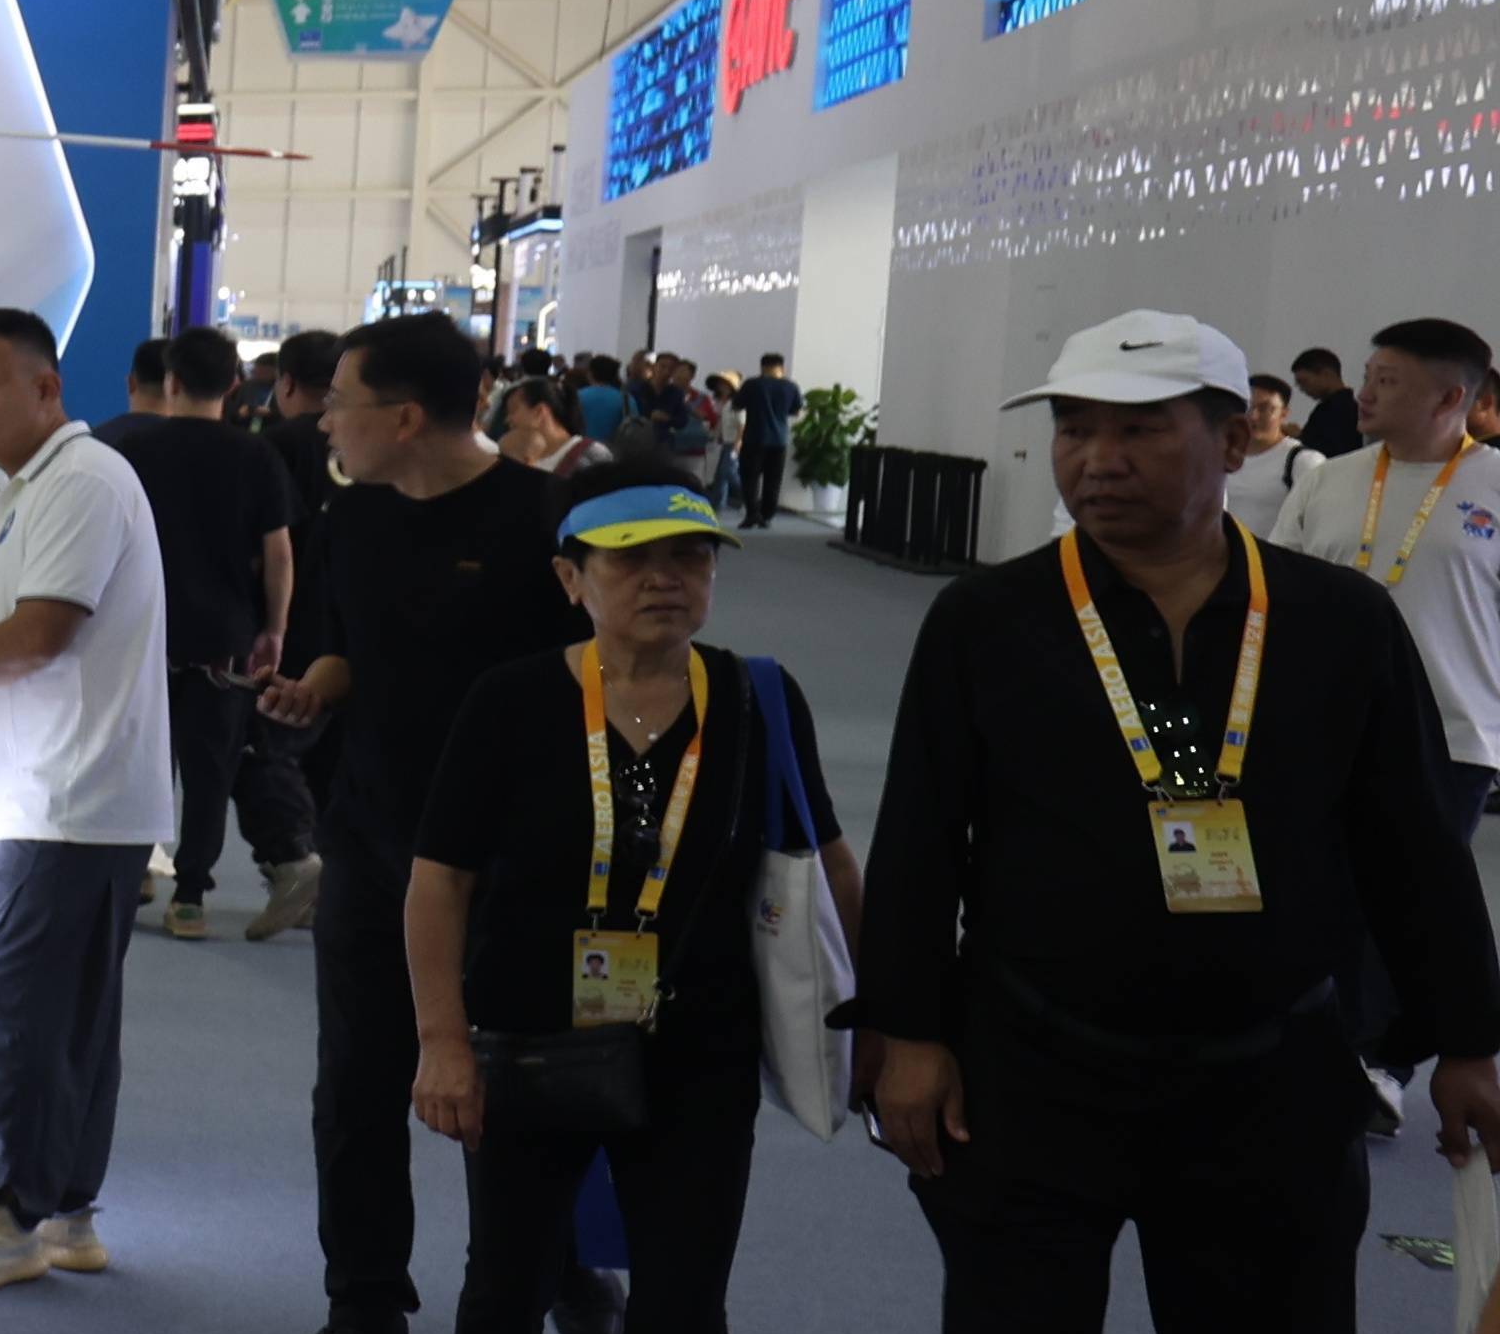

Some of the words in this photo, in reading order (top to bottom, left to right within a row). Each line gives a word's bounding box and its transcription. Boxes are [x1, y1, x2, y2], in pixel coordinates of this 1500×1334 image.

[1075, 599, 1118, 657] ASIA
[1098, 664, 1144, 729] AERO
[587, 731, 612, 783] ASIA
[592, 788, 615, 855] AERO
